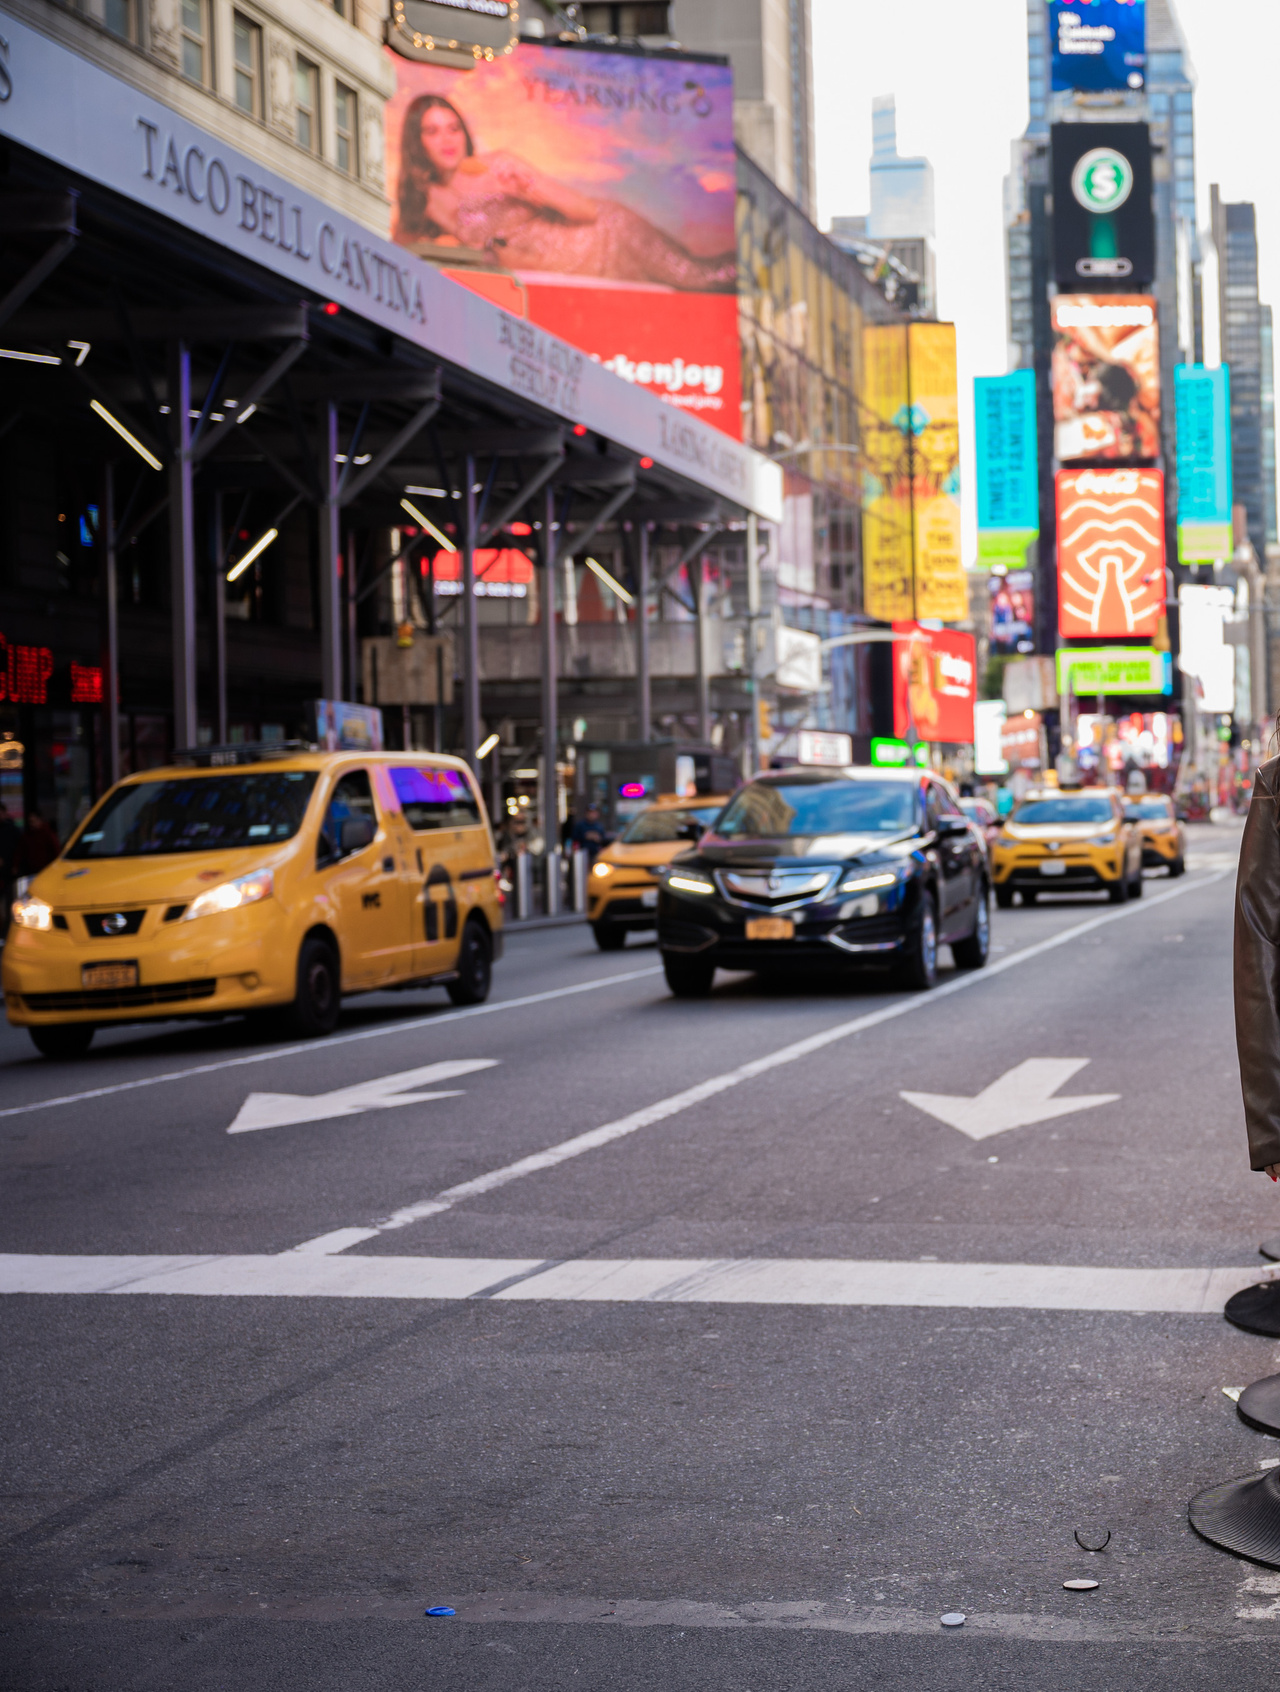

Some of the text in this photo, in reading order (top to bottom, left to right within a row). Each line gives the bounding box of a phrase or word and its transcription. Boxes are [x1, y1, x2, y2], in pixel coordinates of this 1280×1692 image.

[522, 75, 681, 117] YEARNING
[136, 114, 429, 324] TACO BELL CANTINA
[590, 353, 724, 394] kenjoy
